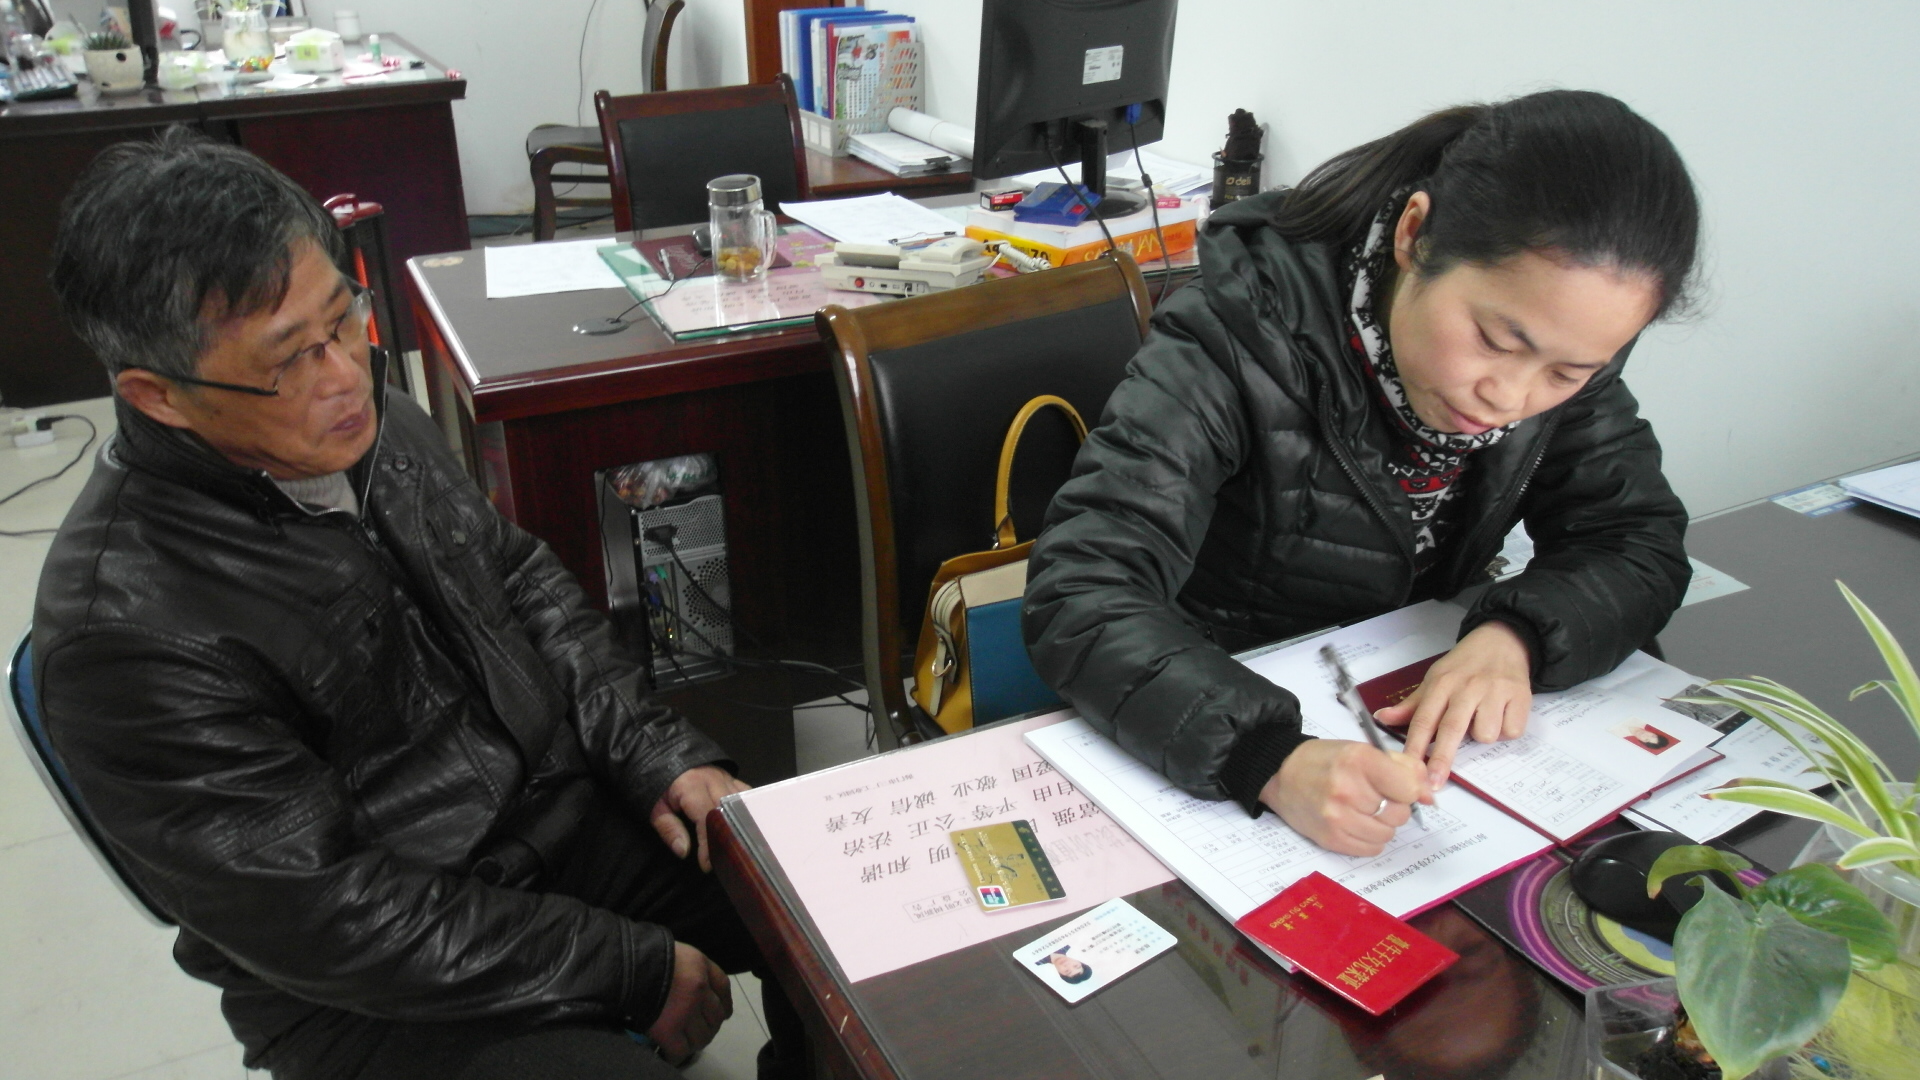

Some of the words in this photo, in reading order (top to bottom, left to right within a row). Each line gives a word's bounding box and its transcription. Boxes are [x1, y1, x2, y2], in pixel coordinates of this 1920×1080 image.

[1235, 176, 1252, 186] deli
[1012, 759, 1055, 783] 爱国
[951, 774, 998, 798] 敬业
[1033, 780, 1075, 802] 自由
[889, 790, 937, 815] 诚信
[971, 796, 1018, 823] 平等
[1052, 801, 1100, 827] 富强
[825, 806, 873, 833] 友善
[907, 813, 956, 840] 公正
[843, 830, 893, 858] 法治
[928, 843, 958, 865] 明
[860, 855, 911, 884] 和谐
[1335, 933, 1411, 990] 独生子女光荣证
